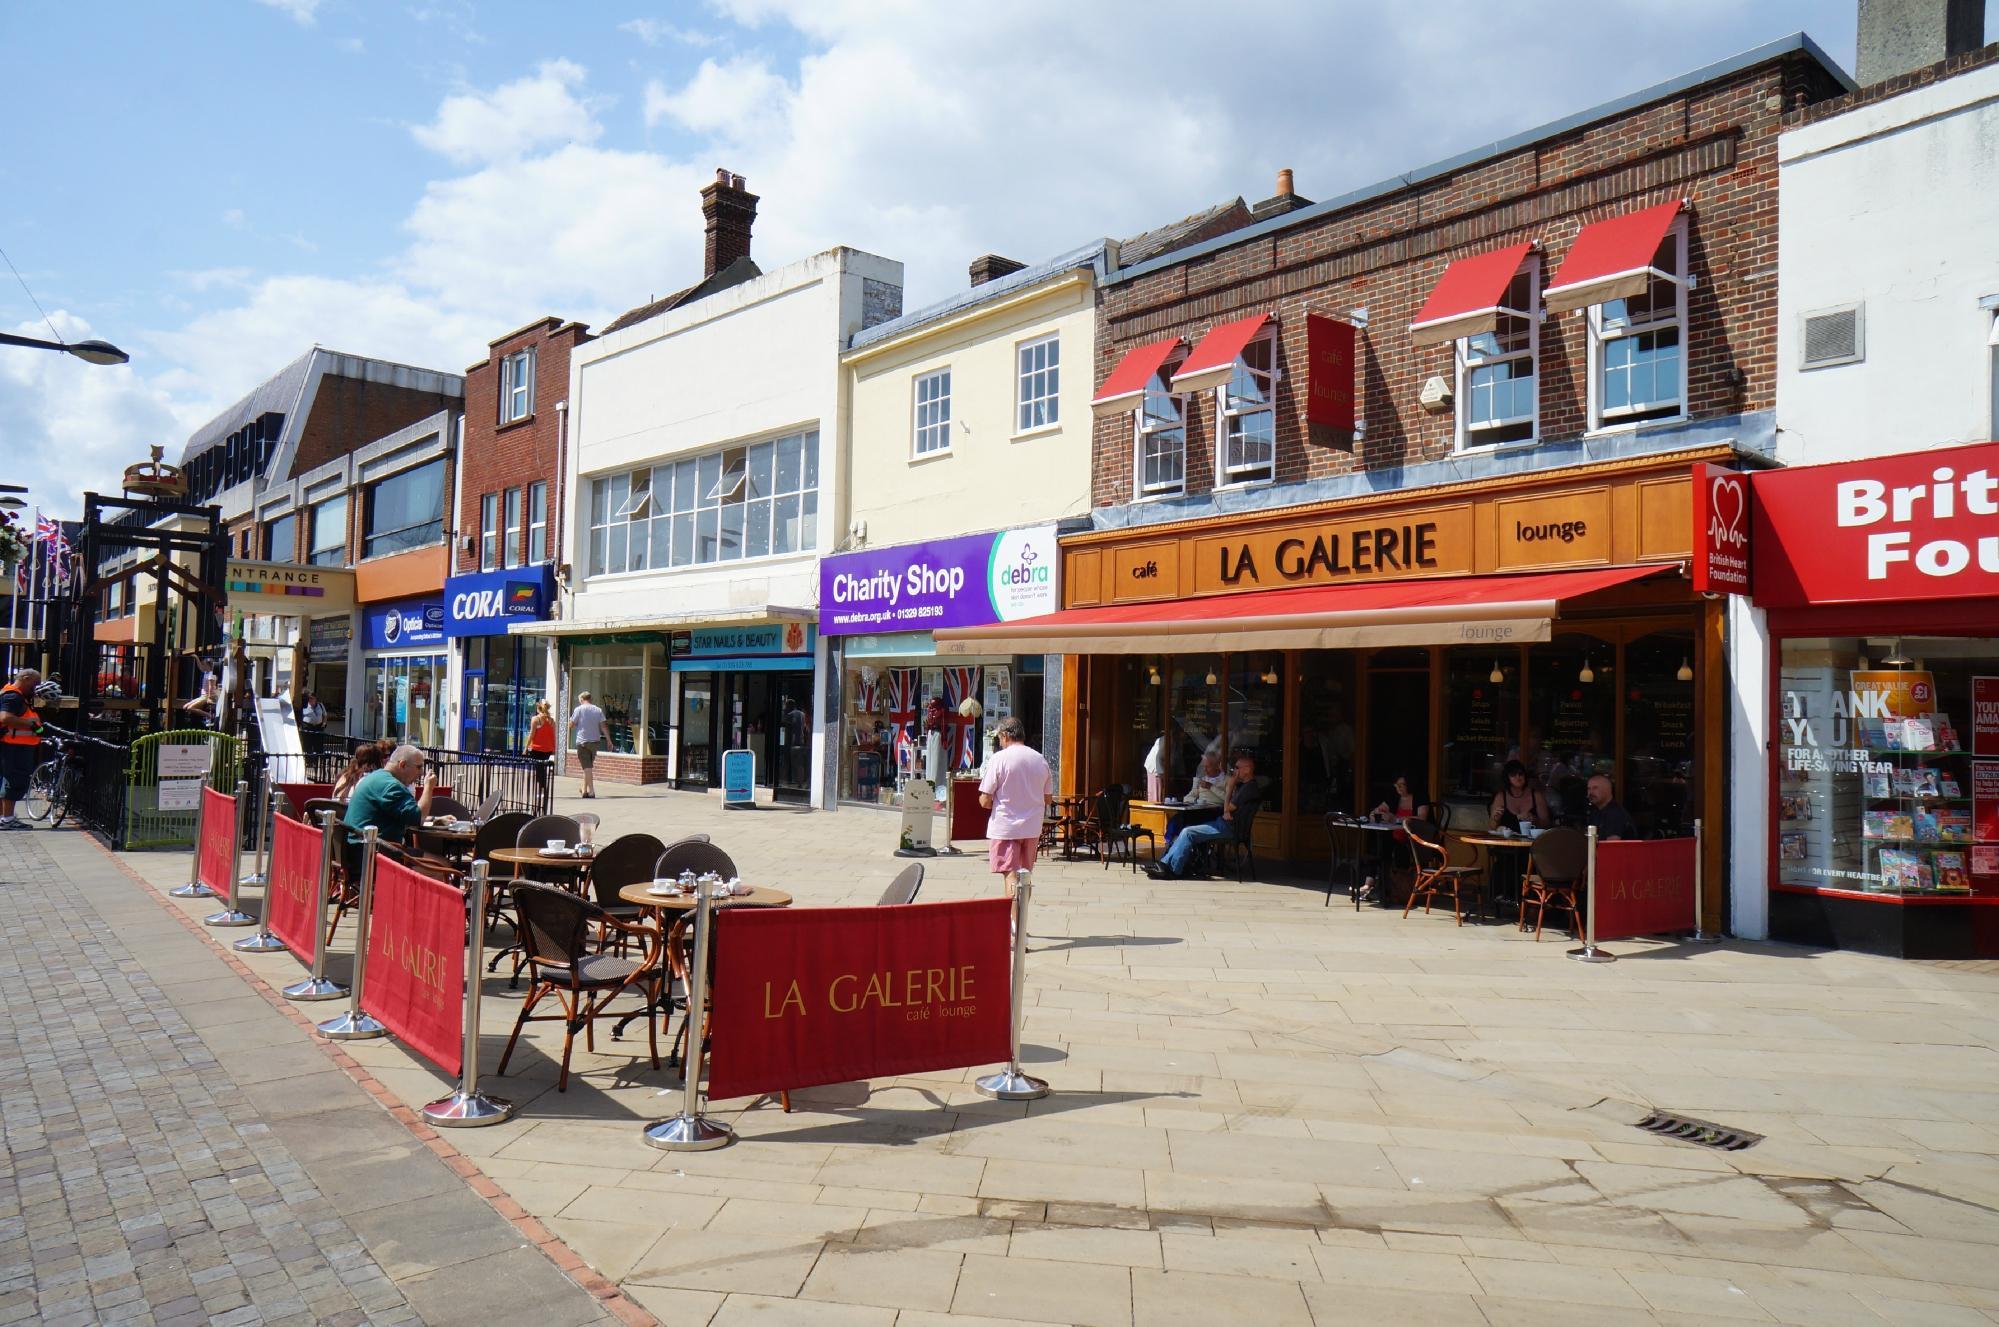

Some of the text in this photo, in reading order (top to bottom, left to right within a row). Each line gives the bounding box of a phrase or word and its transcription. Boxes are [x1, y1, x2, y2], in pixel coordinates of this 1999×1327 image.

[1516, 520, 1586, 544] lounge
[1220, 522, 1438, 584] LA GALERIE
[1709, 552, 1747, 569] British Heart
[226, 568, 320, 584] NTRANCE
[1001, 563, 1049, 586] debra
[1132, 560, 1157, 579] café
[1709, 567, 1747, 584] Foundation
[833, 563, 964, 606] Charity Shop
[452, 589, 513, 620] CORA
[833, 605, 943, 624] www.debra.org.uk 01329 825193
[693, 636, 712, 649] STAR
[713, 634, 736, 648] NAILS
[745, 633, 777, 647] BEAUTY
[1461, 623, 1513, 641] lounge
[1855, 682, 1909, 691] GREAT VALUE
[1914, 685, 1928, 699] £1
[1788, 748, 1810, 760] FOR
[1859, 761, 1893, 774] YEAR
[1823, 868, 1846, 878] EVERY
[383, 921, 394, 961] LA
[764, 965, 976, 1019] LA GALERIE
[906, 1003, 976, 1022] café lounge
